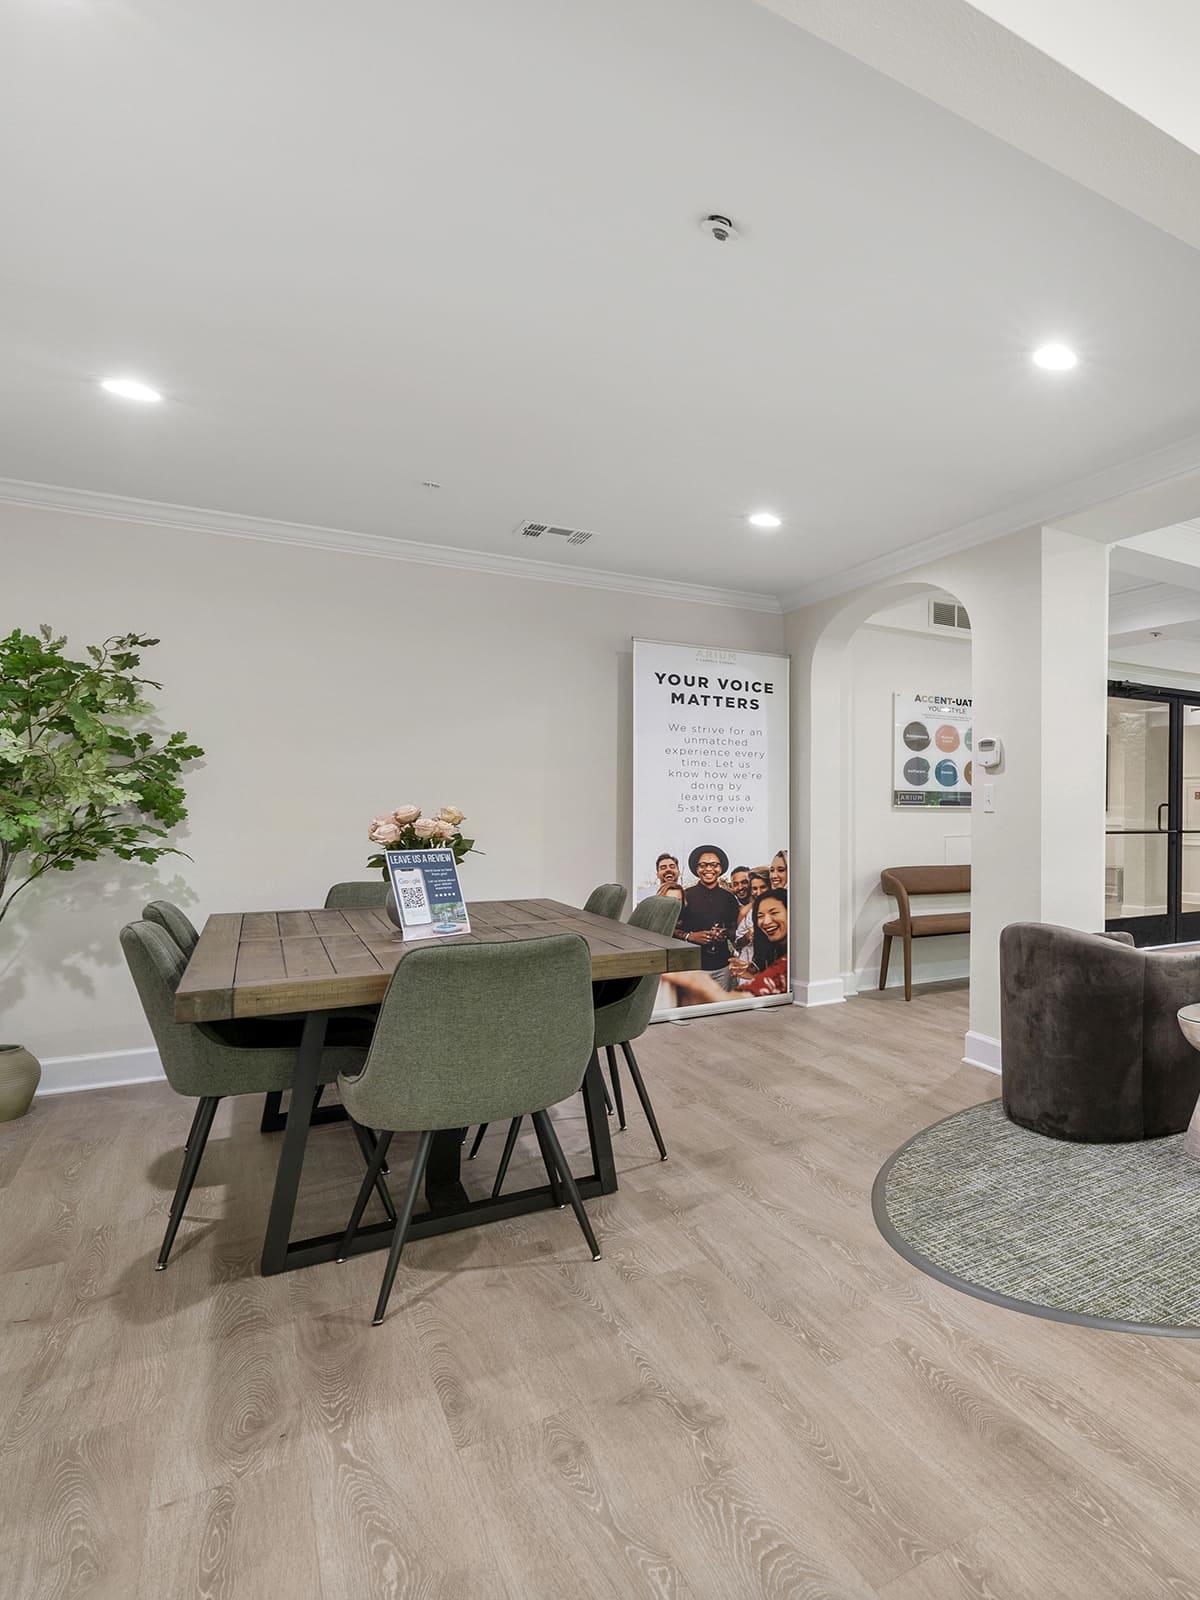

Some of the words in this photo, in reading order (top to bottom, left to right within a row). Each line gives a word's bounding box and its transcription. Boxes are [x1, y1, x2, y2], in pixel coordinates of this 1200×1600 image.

[654, 672, 709, 689] YOUR
[717, 678, 774, 694] VOICE
[671, 692, 760, 710] MATTERS
[668, 723, 687, 732] We
[691, 725, 725, 734] strive
[729, 727, 744, 735] for
[684, 737, 748, 746] unmatched
[664, 747, 730, 757] experience
[734, 750, 765, 760] every
[681, 759, 711, 767] time.
[715, 760, 733, 768] Let
[738, 761, 751, 769] us
[668, 769, 699, 778] know
[704, 770, 728, 779] how
[733, 771, 762, 780] we're
[690, 782, 724, 791] doing
[728, 782, 742, 791] by
[680, 793, 724, 803] leaving
[744, 794, 751, 802] a
[677, 803, 713, 813] 5-star
[717, 805, 754, 813] review
[684, 816, 698, 824] on
[390, 854, 411, 865] LEAVE
[412, 854, 421, 864] US
[422, 854, 428, 863] A
[428, 853, 451, 863] REVIEW
